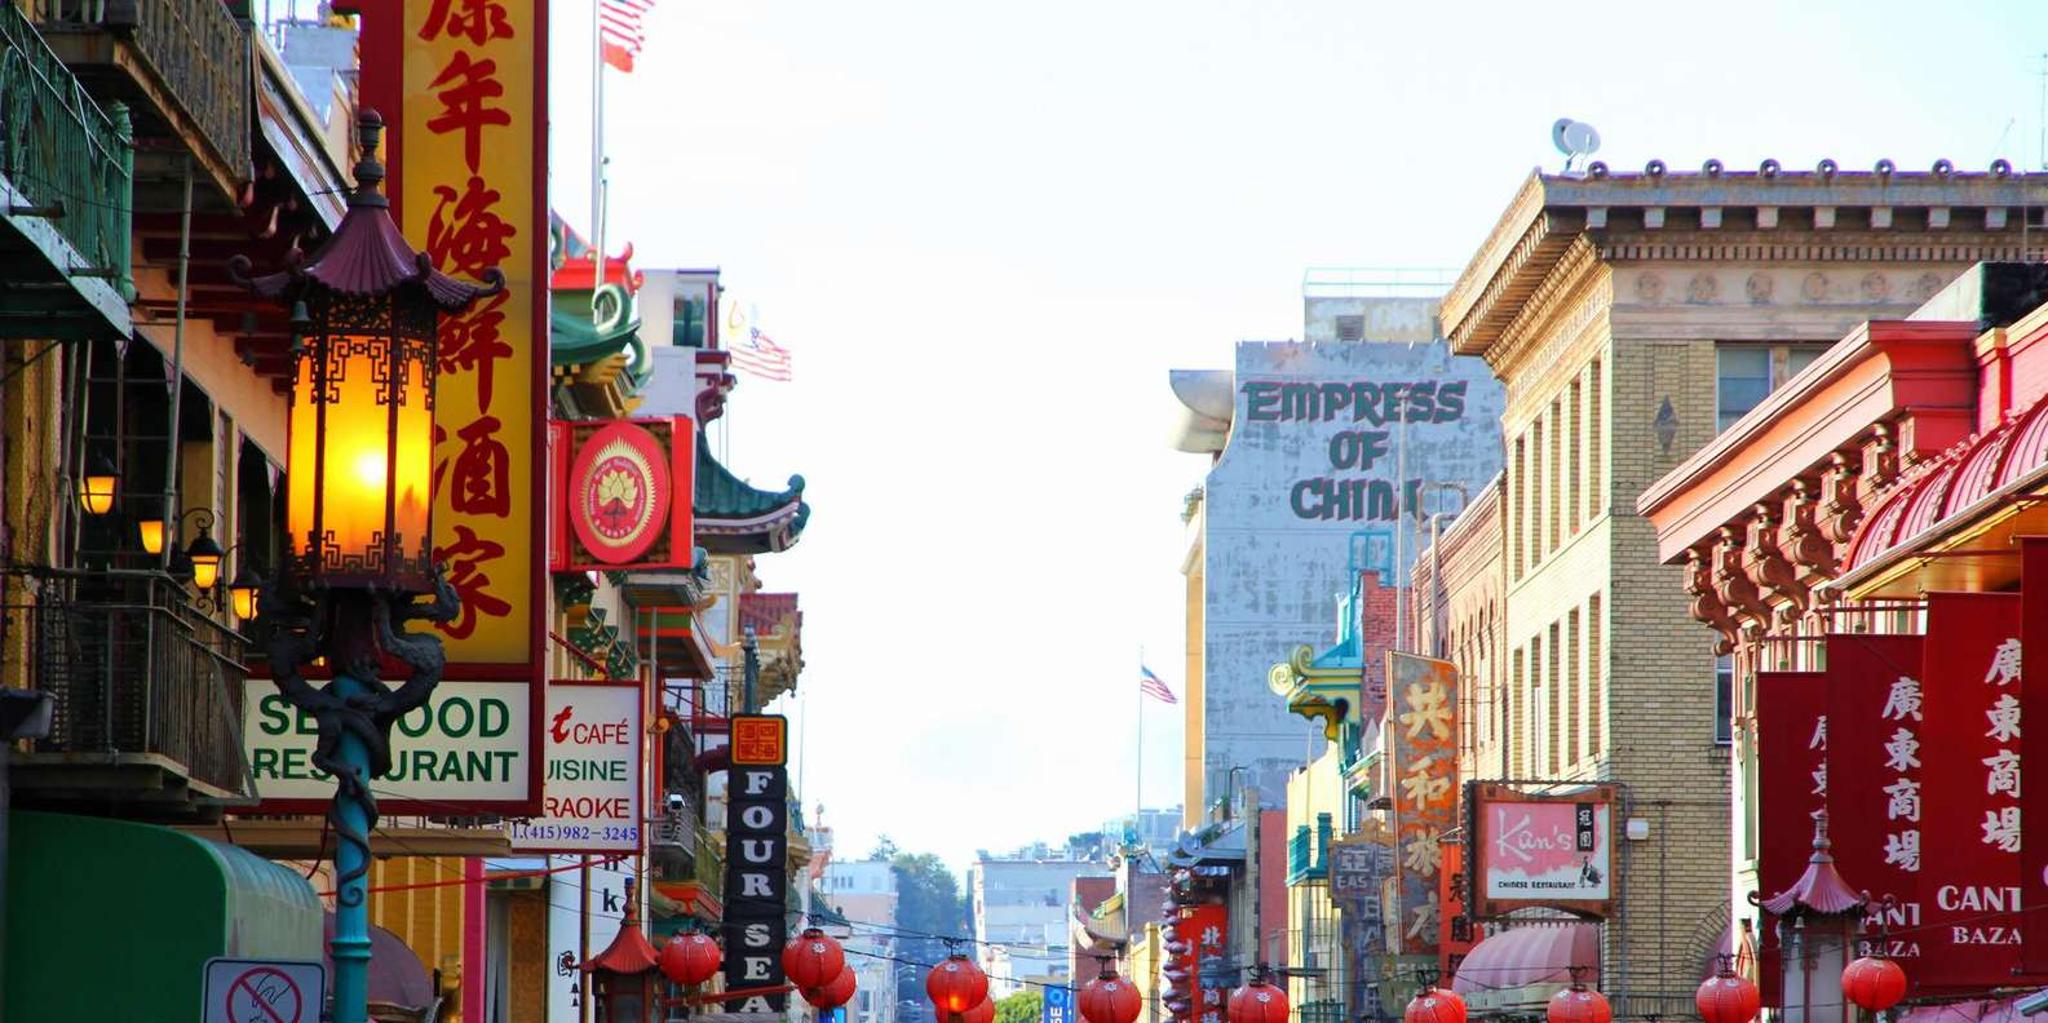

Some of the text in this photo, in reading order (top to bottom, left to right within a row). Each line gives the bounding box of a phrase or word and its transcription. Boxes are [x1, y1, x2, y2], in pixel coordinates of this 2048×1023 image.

[1240, 379, 1468, 426] EMPRESS
[1329, 431, 1390, 471] OF
[259, 694, 510, 738] SEOOD
[573, 718, 629, 745] CAFÉ
[1881, 676, 1923, 872] 廣東商場
[741, 771, 774, 896] FOUR
[1496, 807, 1573, 863] Kan's
[1861, 902, 1921, 926] ANT
